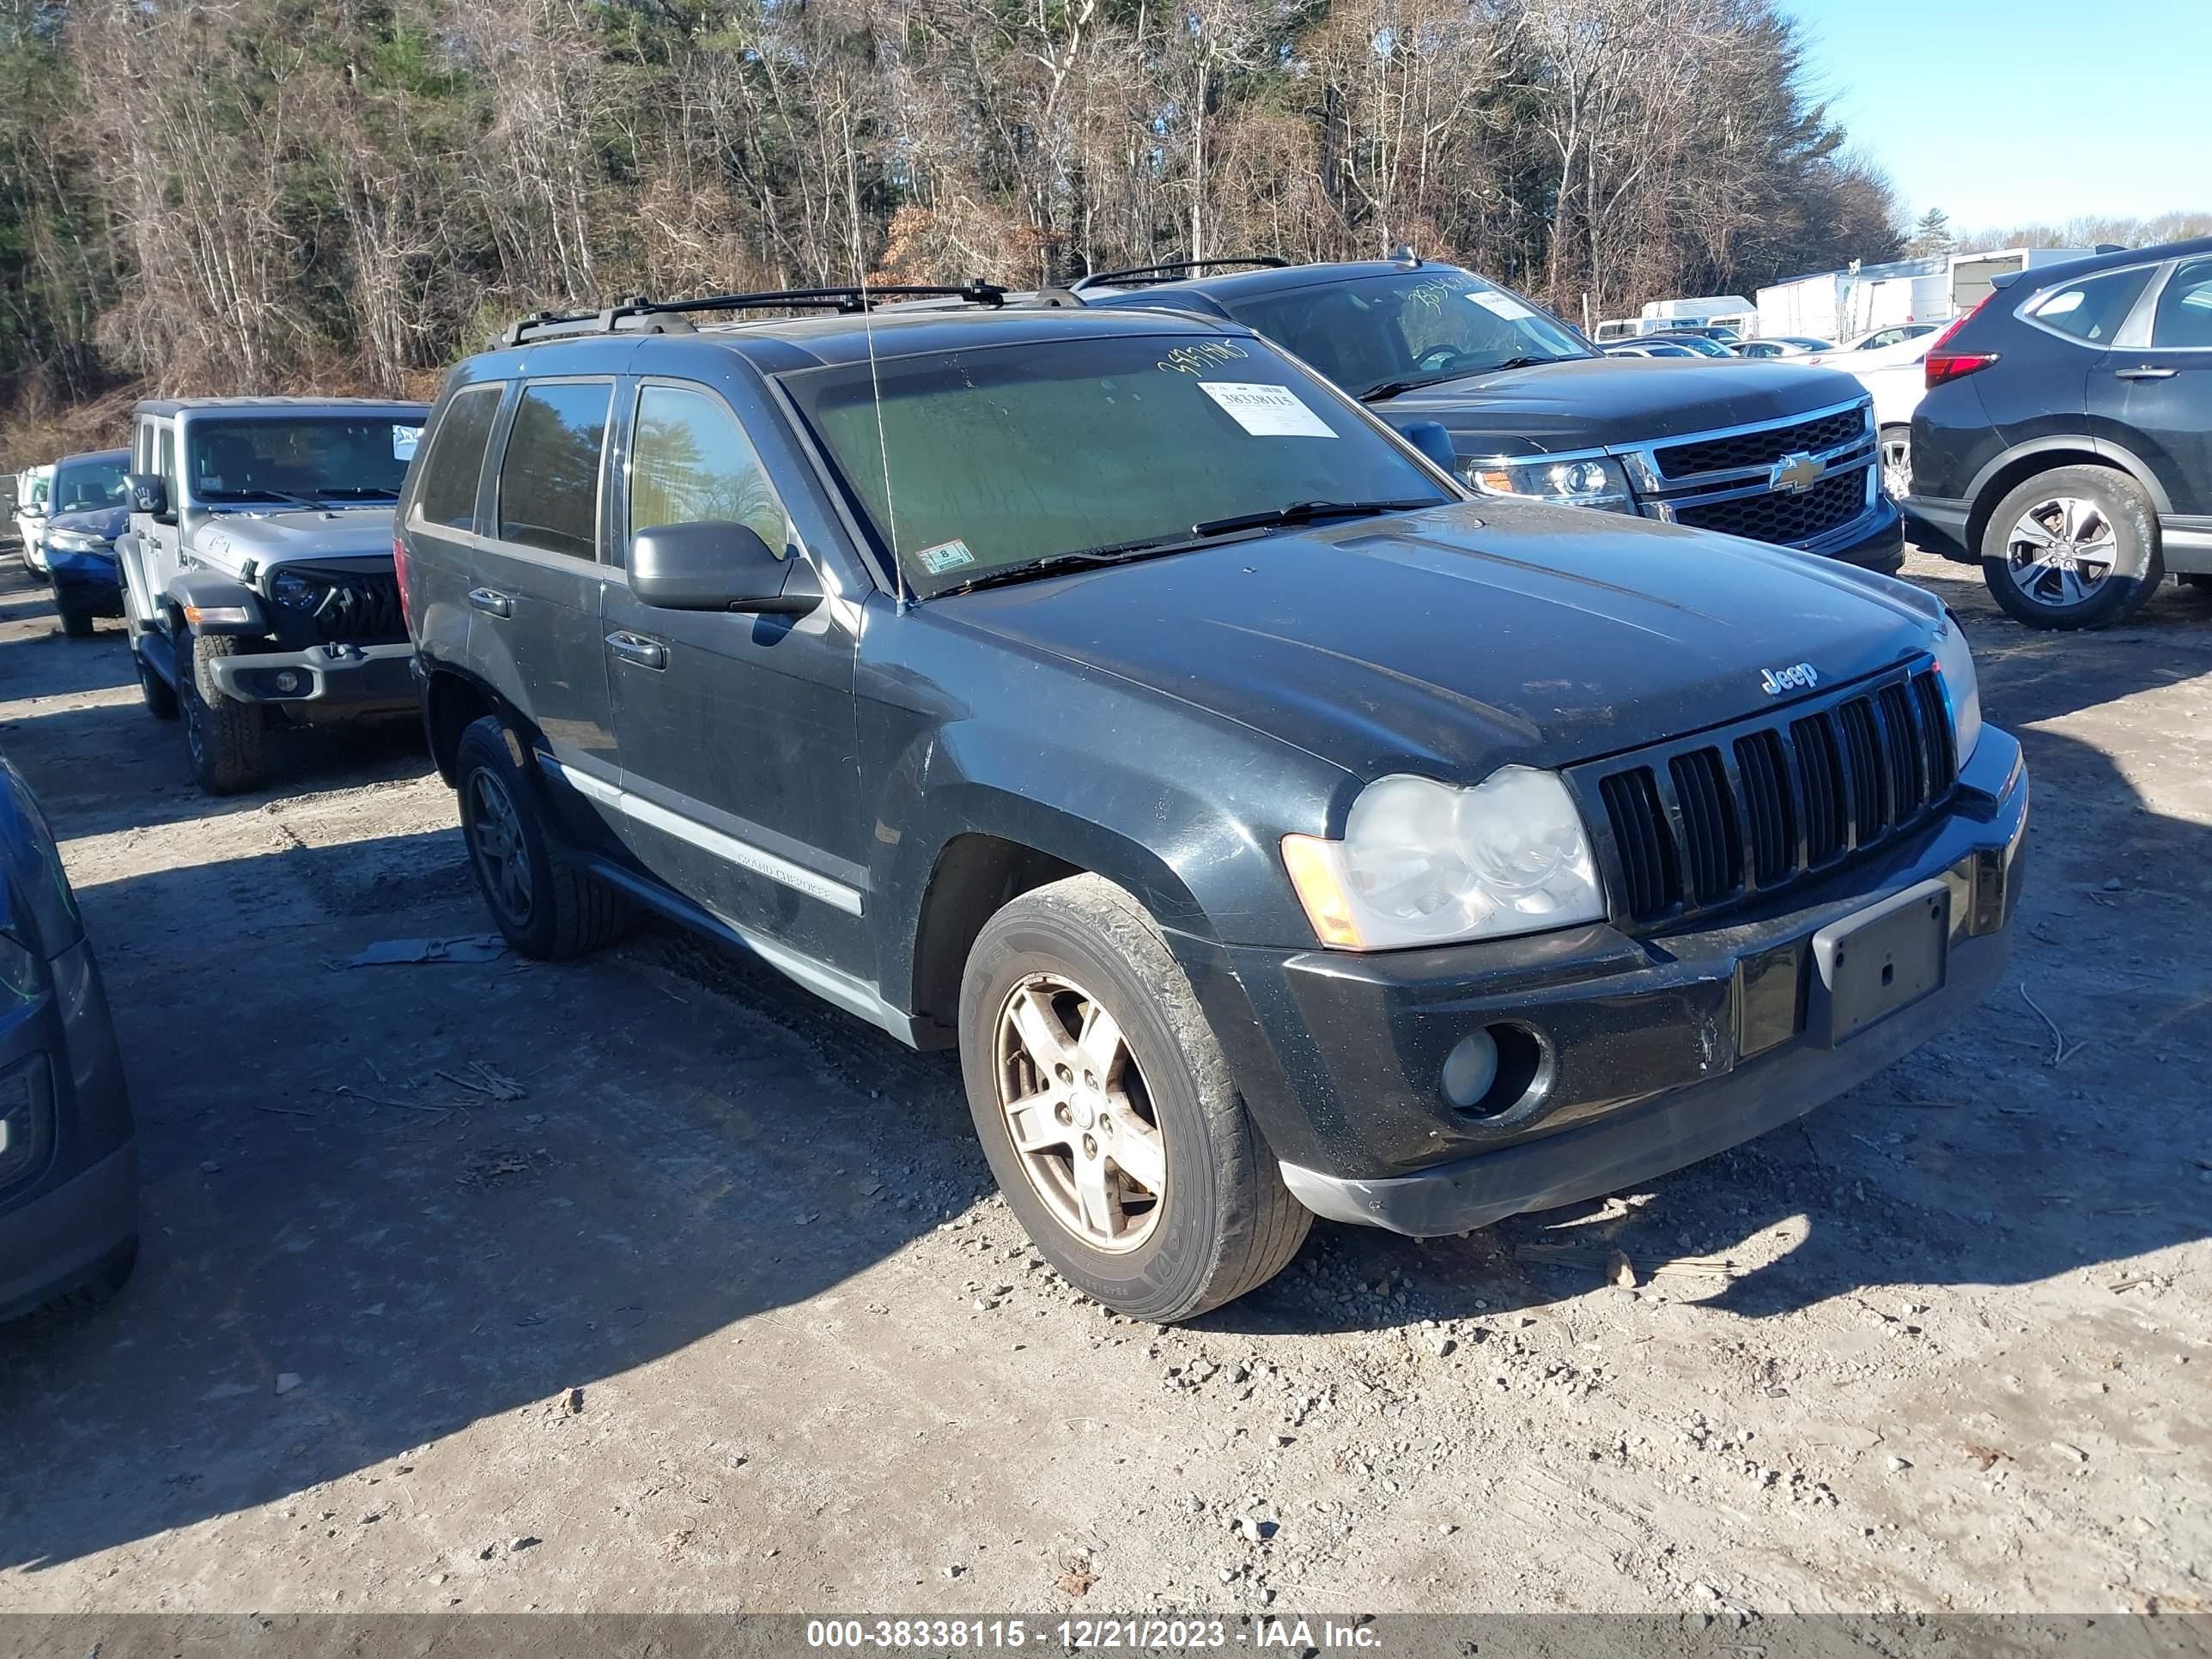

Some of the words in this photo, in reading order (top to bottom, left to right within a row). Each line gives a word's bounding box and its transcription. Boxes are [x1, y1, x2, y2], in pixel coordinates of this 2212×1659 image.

[1220, 392, 1295, 406] 38338115
[1760, 662, 1818, 695] Jeep
[738, 853, 774, 875] GRAND
[775, 869, 833, 902] CHEROKEE
